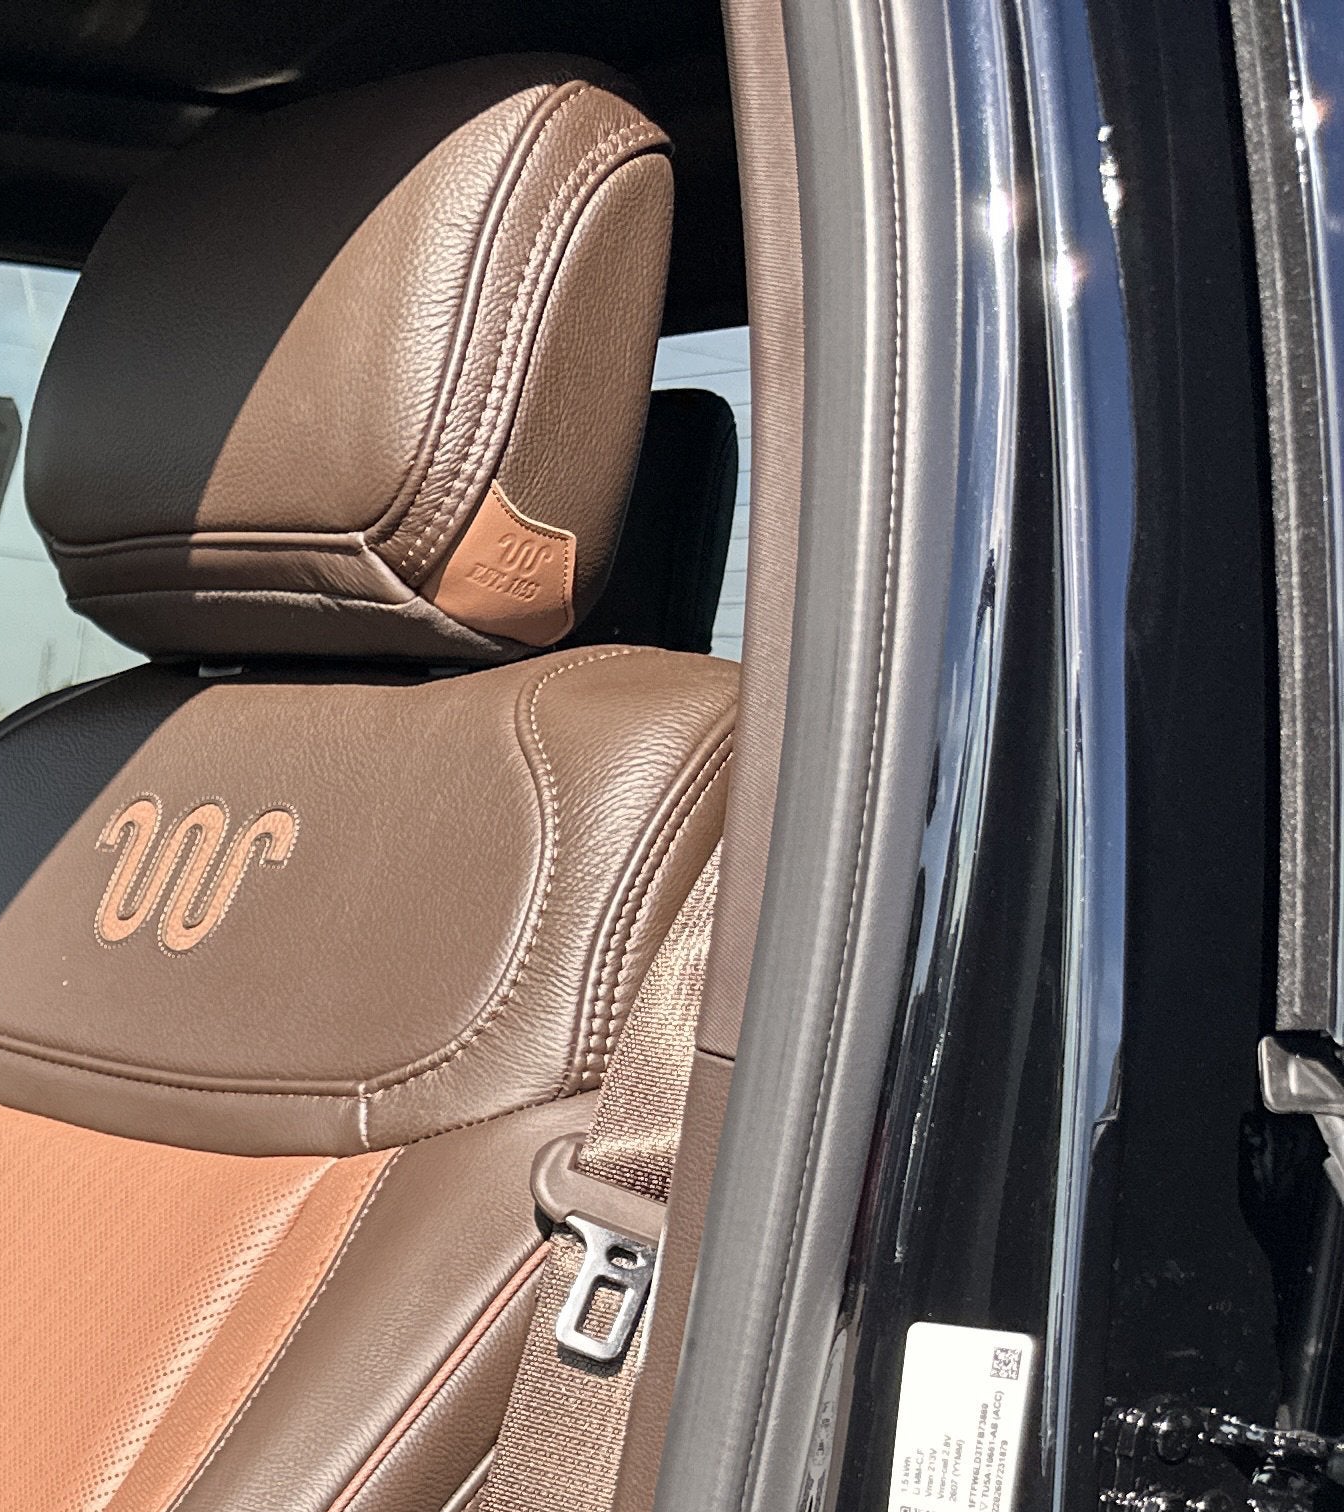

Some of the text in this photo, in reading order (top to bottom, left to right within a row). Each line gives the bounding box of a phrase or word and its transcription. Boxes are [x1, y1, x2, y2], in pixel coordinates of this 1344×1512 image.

[466, 561, 541, 602] EST. 1853
[990, 1389, 1005, 1420] (ACC)
[926, 1447, 938, 1472] 213V
[948, 1478, 960, 1502] 2607
